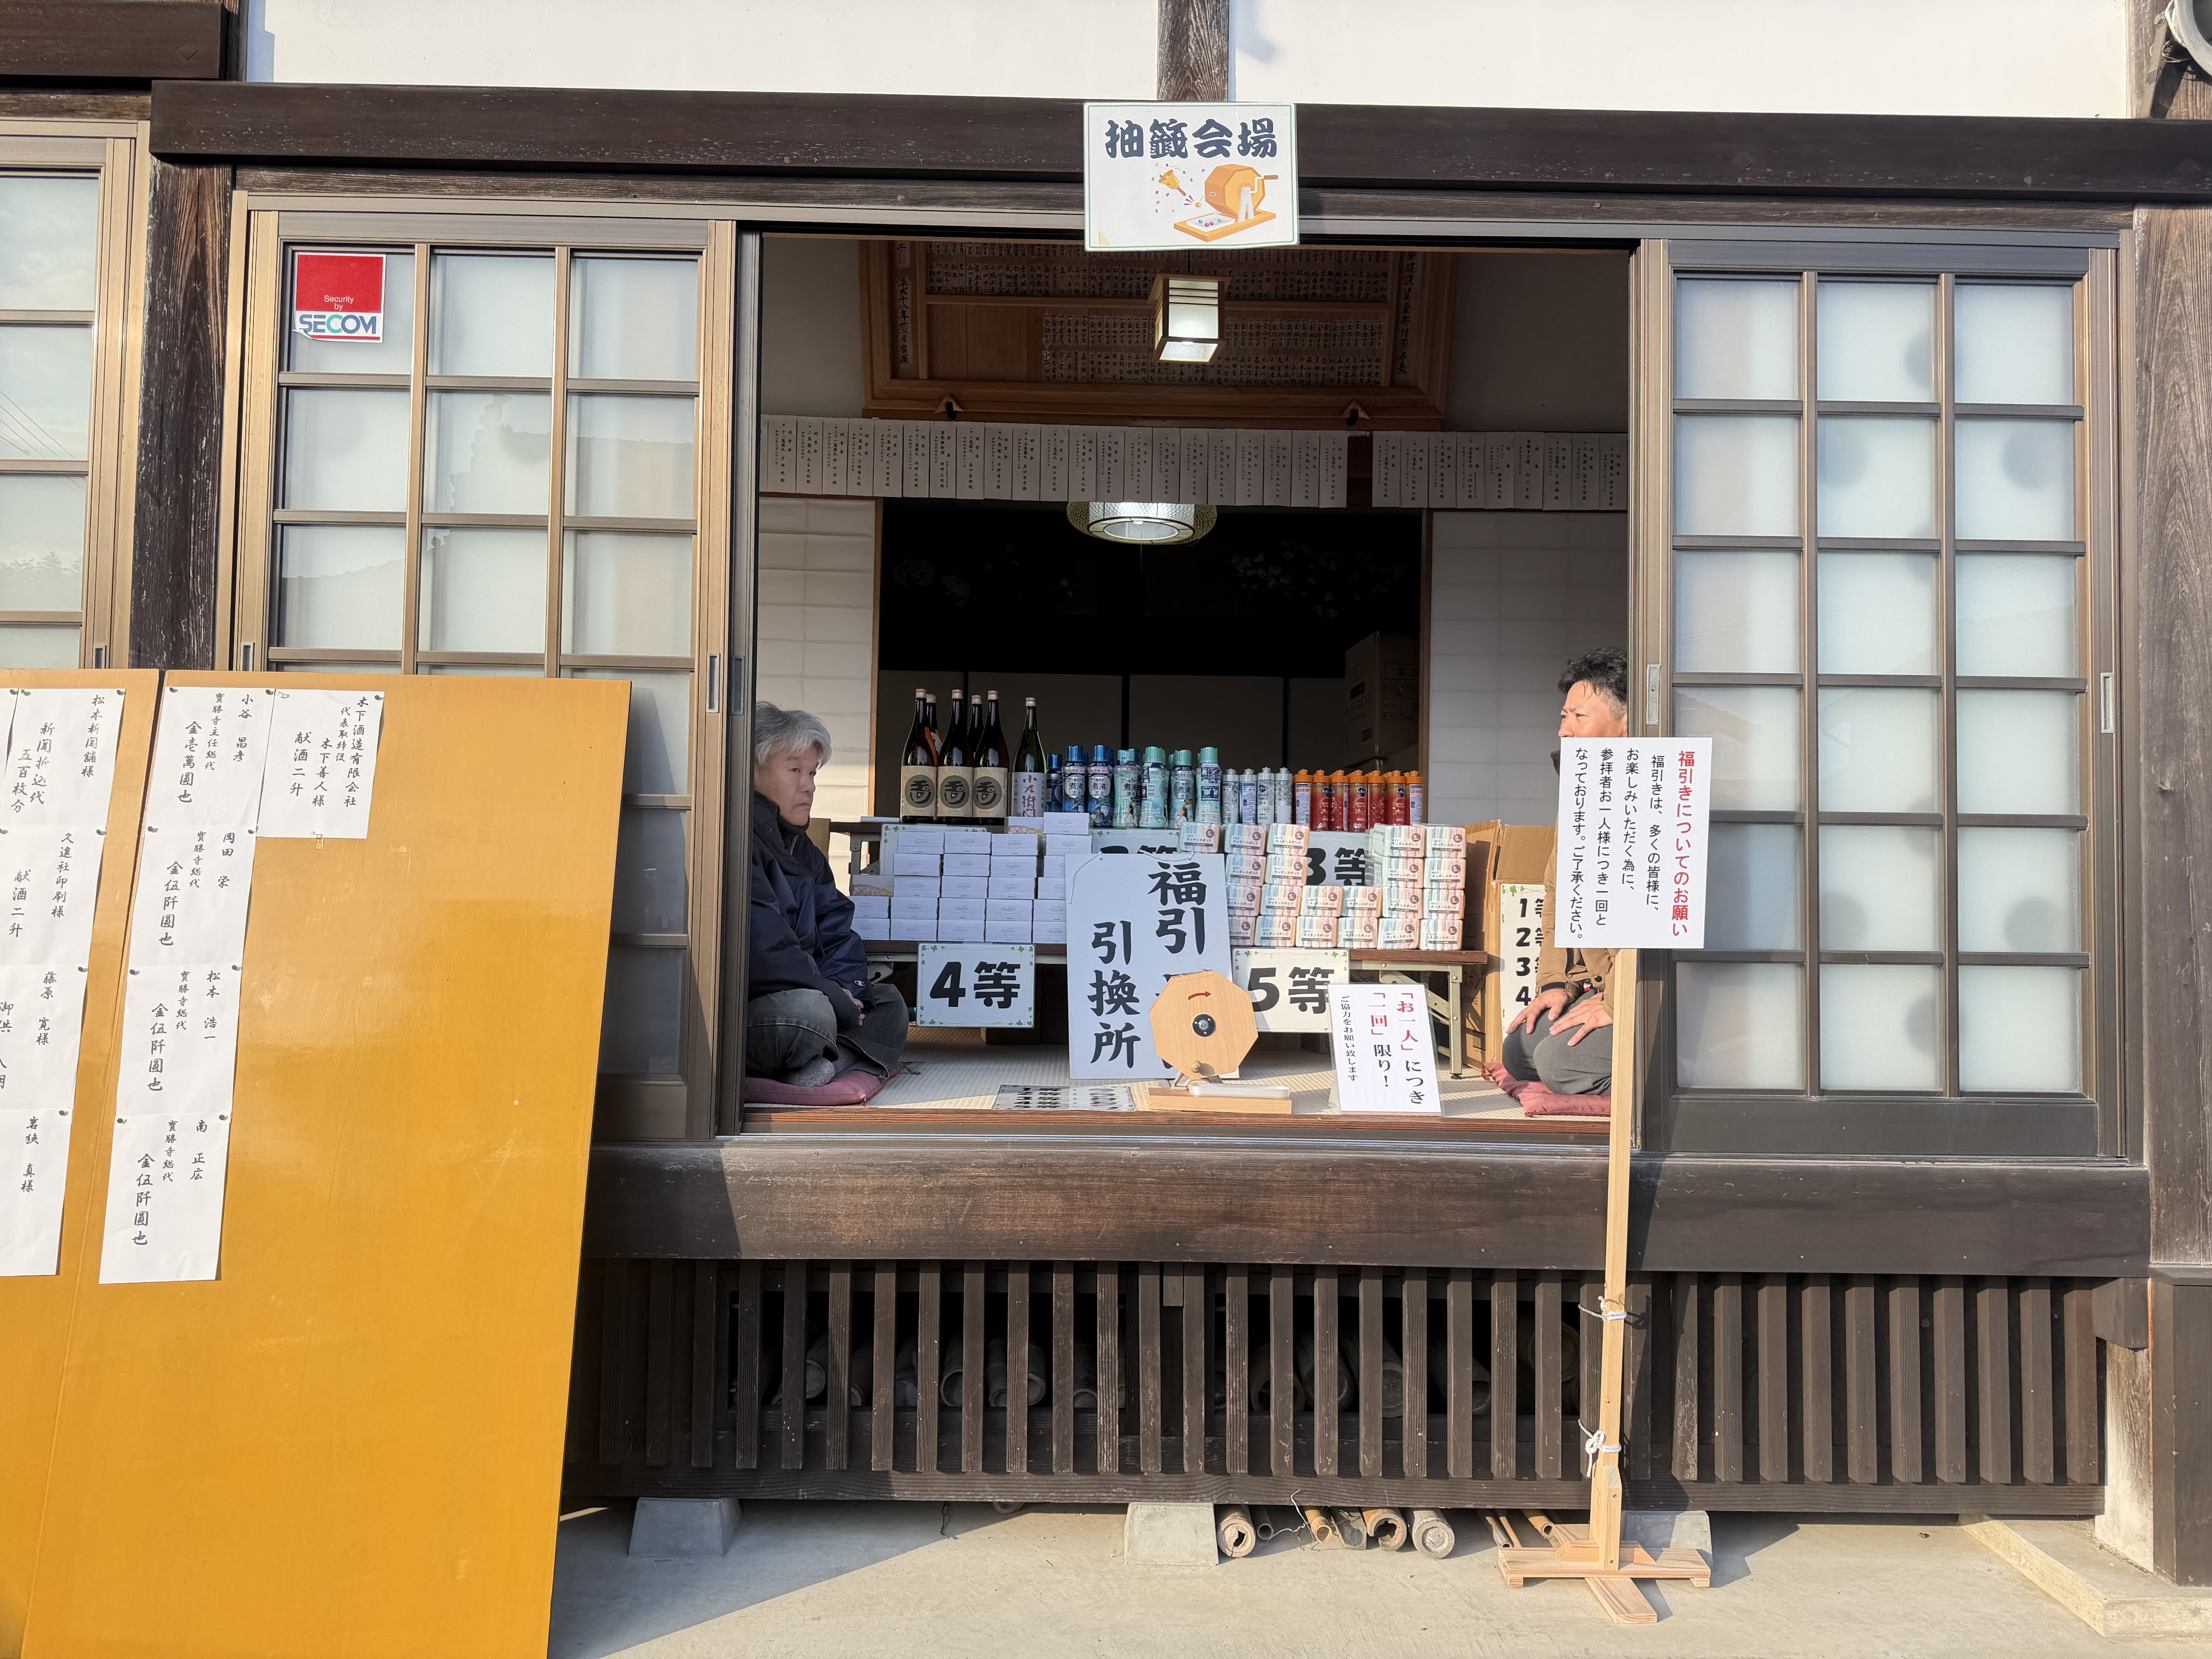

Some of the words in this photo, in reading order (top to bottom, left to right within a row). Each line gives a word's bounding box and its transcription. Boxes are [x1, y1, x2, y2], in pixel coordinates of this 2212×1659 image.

[1105, 118, 1277, 158] 抽籤会場
[324, 295, 354, 304] Security
[334, 303, 343, 311] by
[299, 314, 376, 334] SECOM
[239, 694, 253, 719] 小谷
[233, 737, 247, 761] 昌彦
[335, 707, 350, 762] 代表取締役
[343, 697, 368, 807] 木下酒造有限会社
[11, 749, 32, 813] 五百枚分
[290, 732, 311, 796] 献酒二升
[312, 738, 332, 807] 木下善人様
[1595, 748, 1613, 925] 参拝者お一人様につき一回と
[1622, 748, 1638, 889] お楽しみいただく為に、
[1647, 755, 1664, 910] 福引きは、多くの皆様に、
[222, 833, 235, 857] 岡田
[1570, 748, 1587, 938] なっております。ご了承ください。
[1672, 750, 1695, 936] 福引きについてのお願い
[9, 870, 31, 937] 献酒二升
[218, 876, 230, 888] 栄
[41, 971, 57, 1000] 藤原
[207, 970, 220, 998] 松本
[930, 961, 1020, 1009] 4等
[1087, 921, 1141, 1068] 引換所
[1247, 967, 1334, 1014] 5等
[204, 1017, 217, 1039] 浩一
[1341, 996, 1358, 1082] ご協力をお願い致します
[1396, 993, 1425, 1104] 「お一人」につき
[196, 1120, 207, 1132] 南
[190, 1152, 205, 1180] 正広
